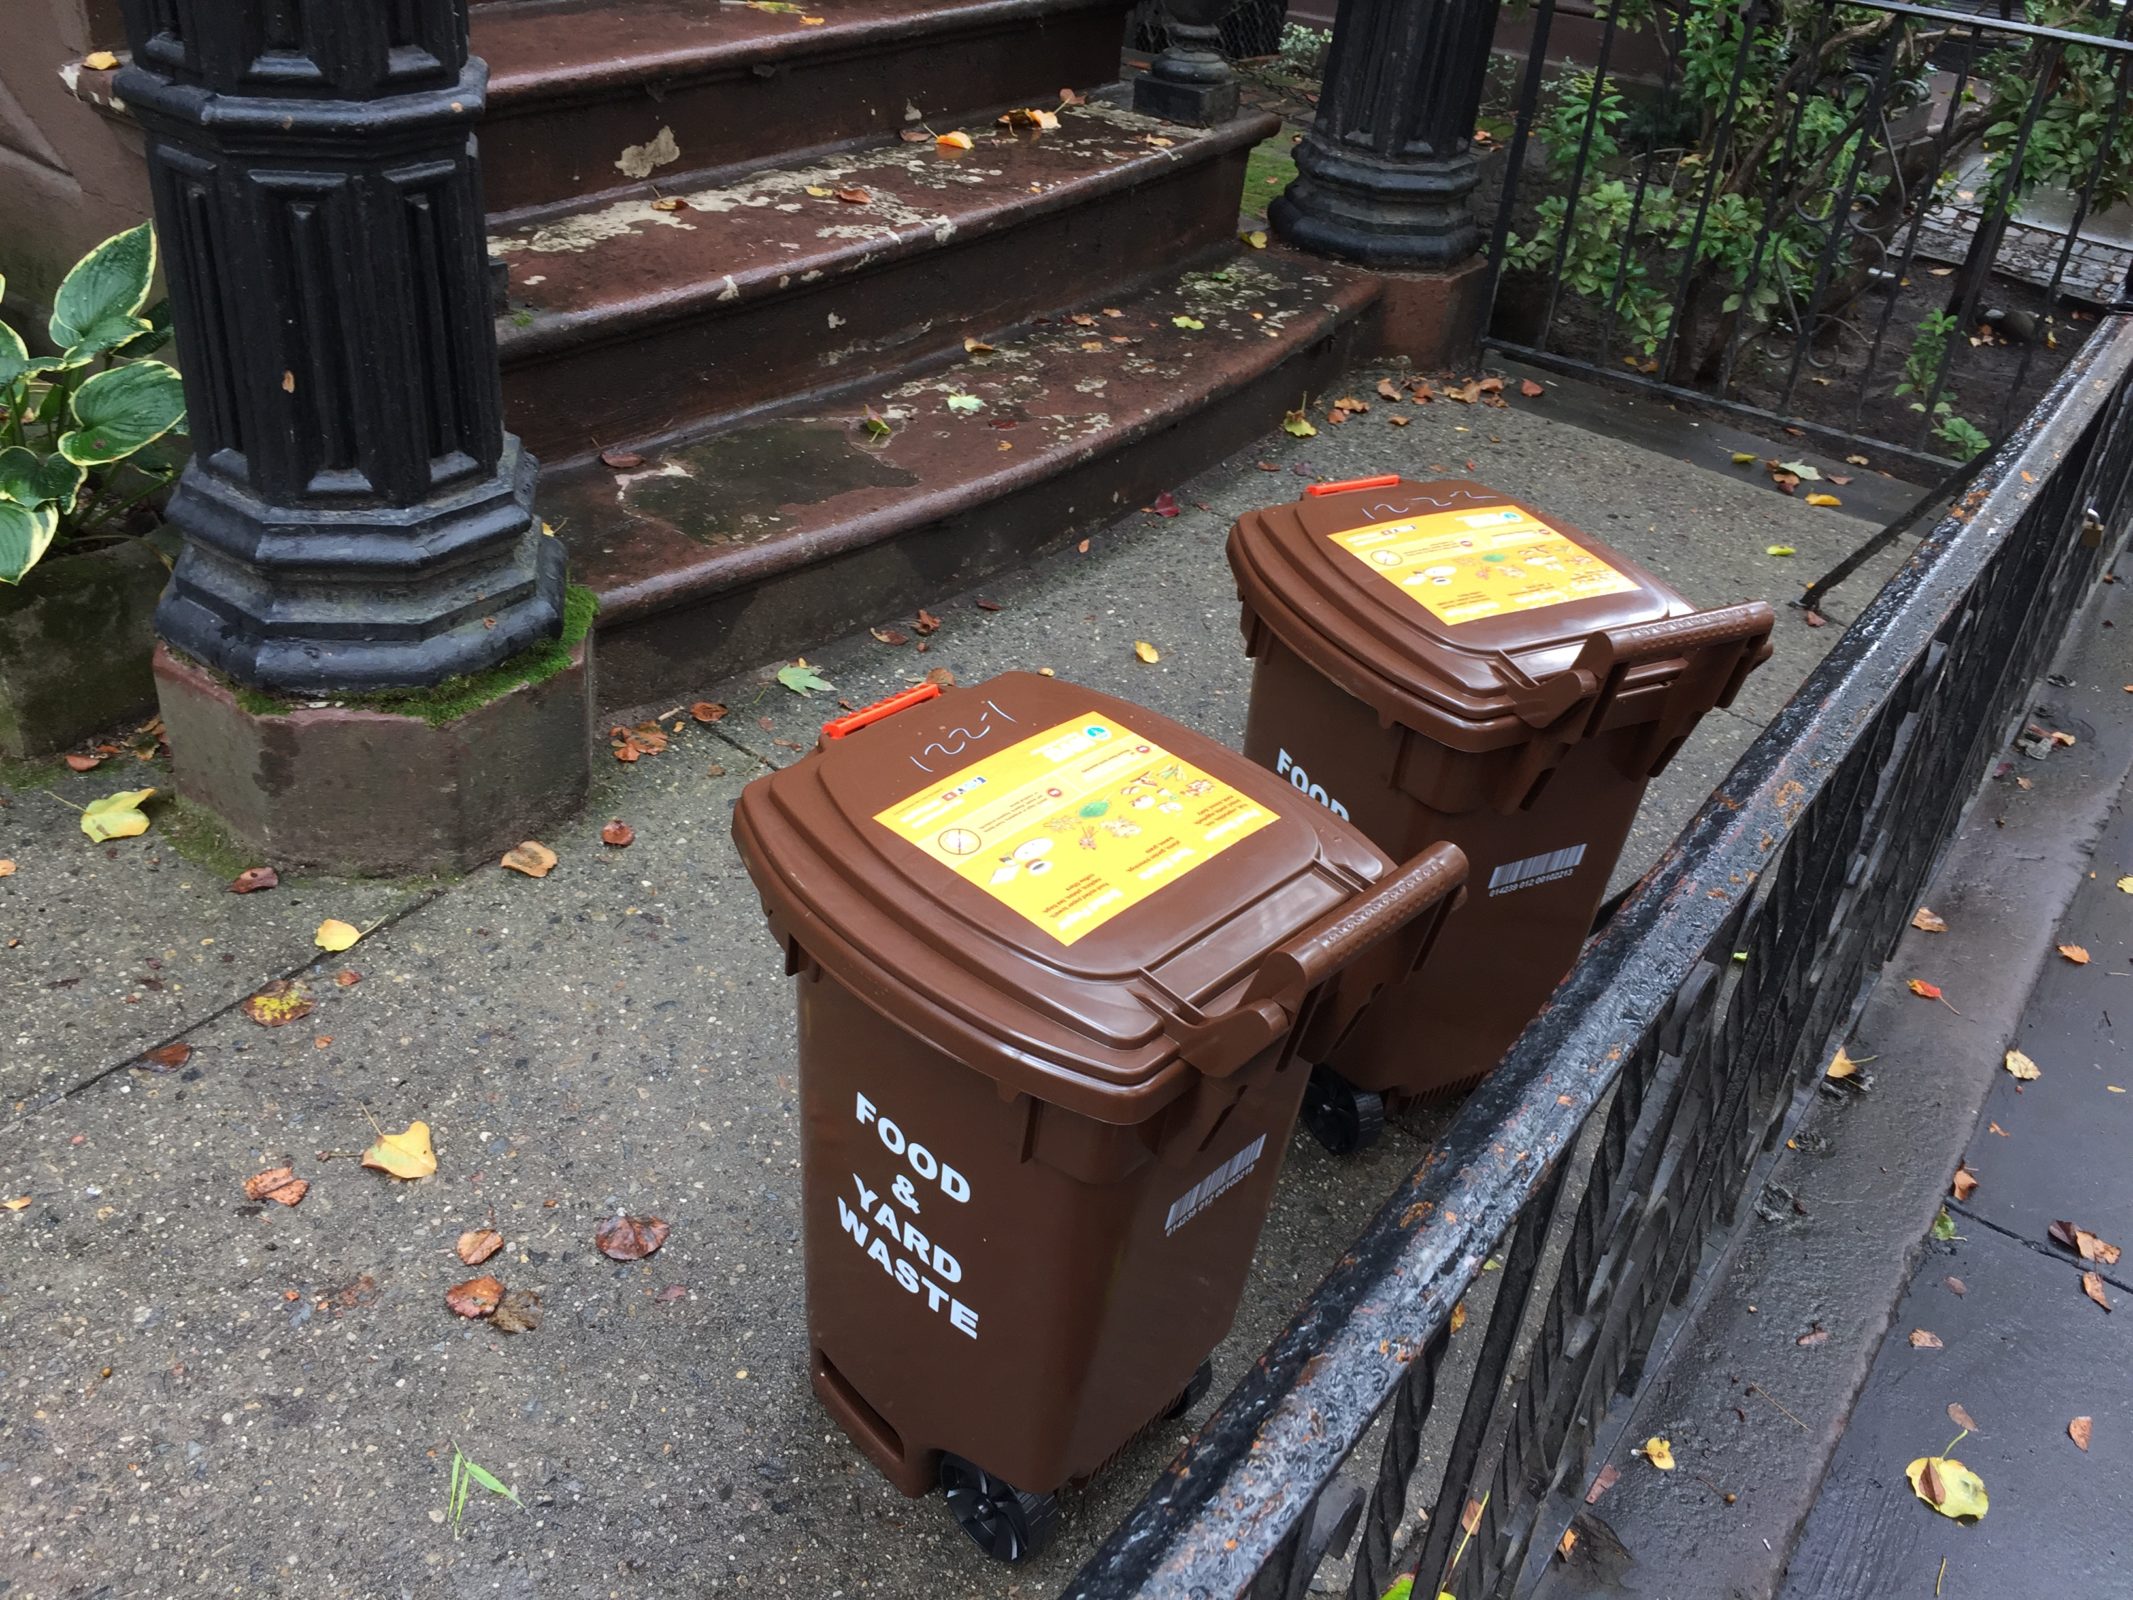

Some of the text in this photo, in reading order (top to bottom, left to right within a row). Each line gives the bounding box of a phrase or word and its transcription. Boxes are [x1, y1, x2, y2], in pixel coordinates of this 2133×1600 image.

[856, 1091, 971, 1203] FOOD
[891, 1174, 921, 1214] &
[837, 1196, 979, 1340] WASTE
[853, 1173, 962, 1283] YARD
